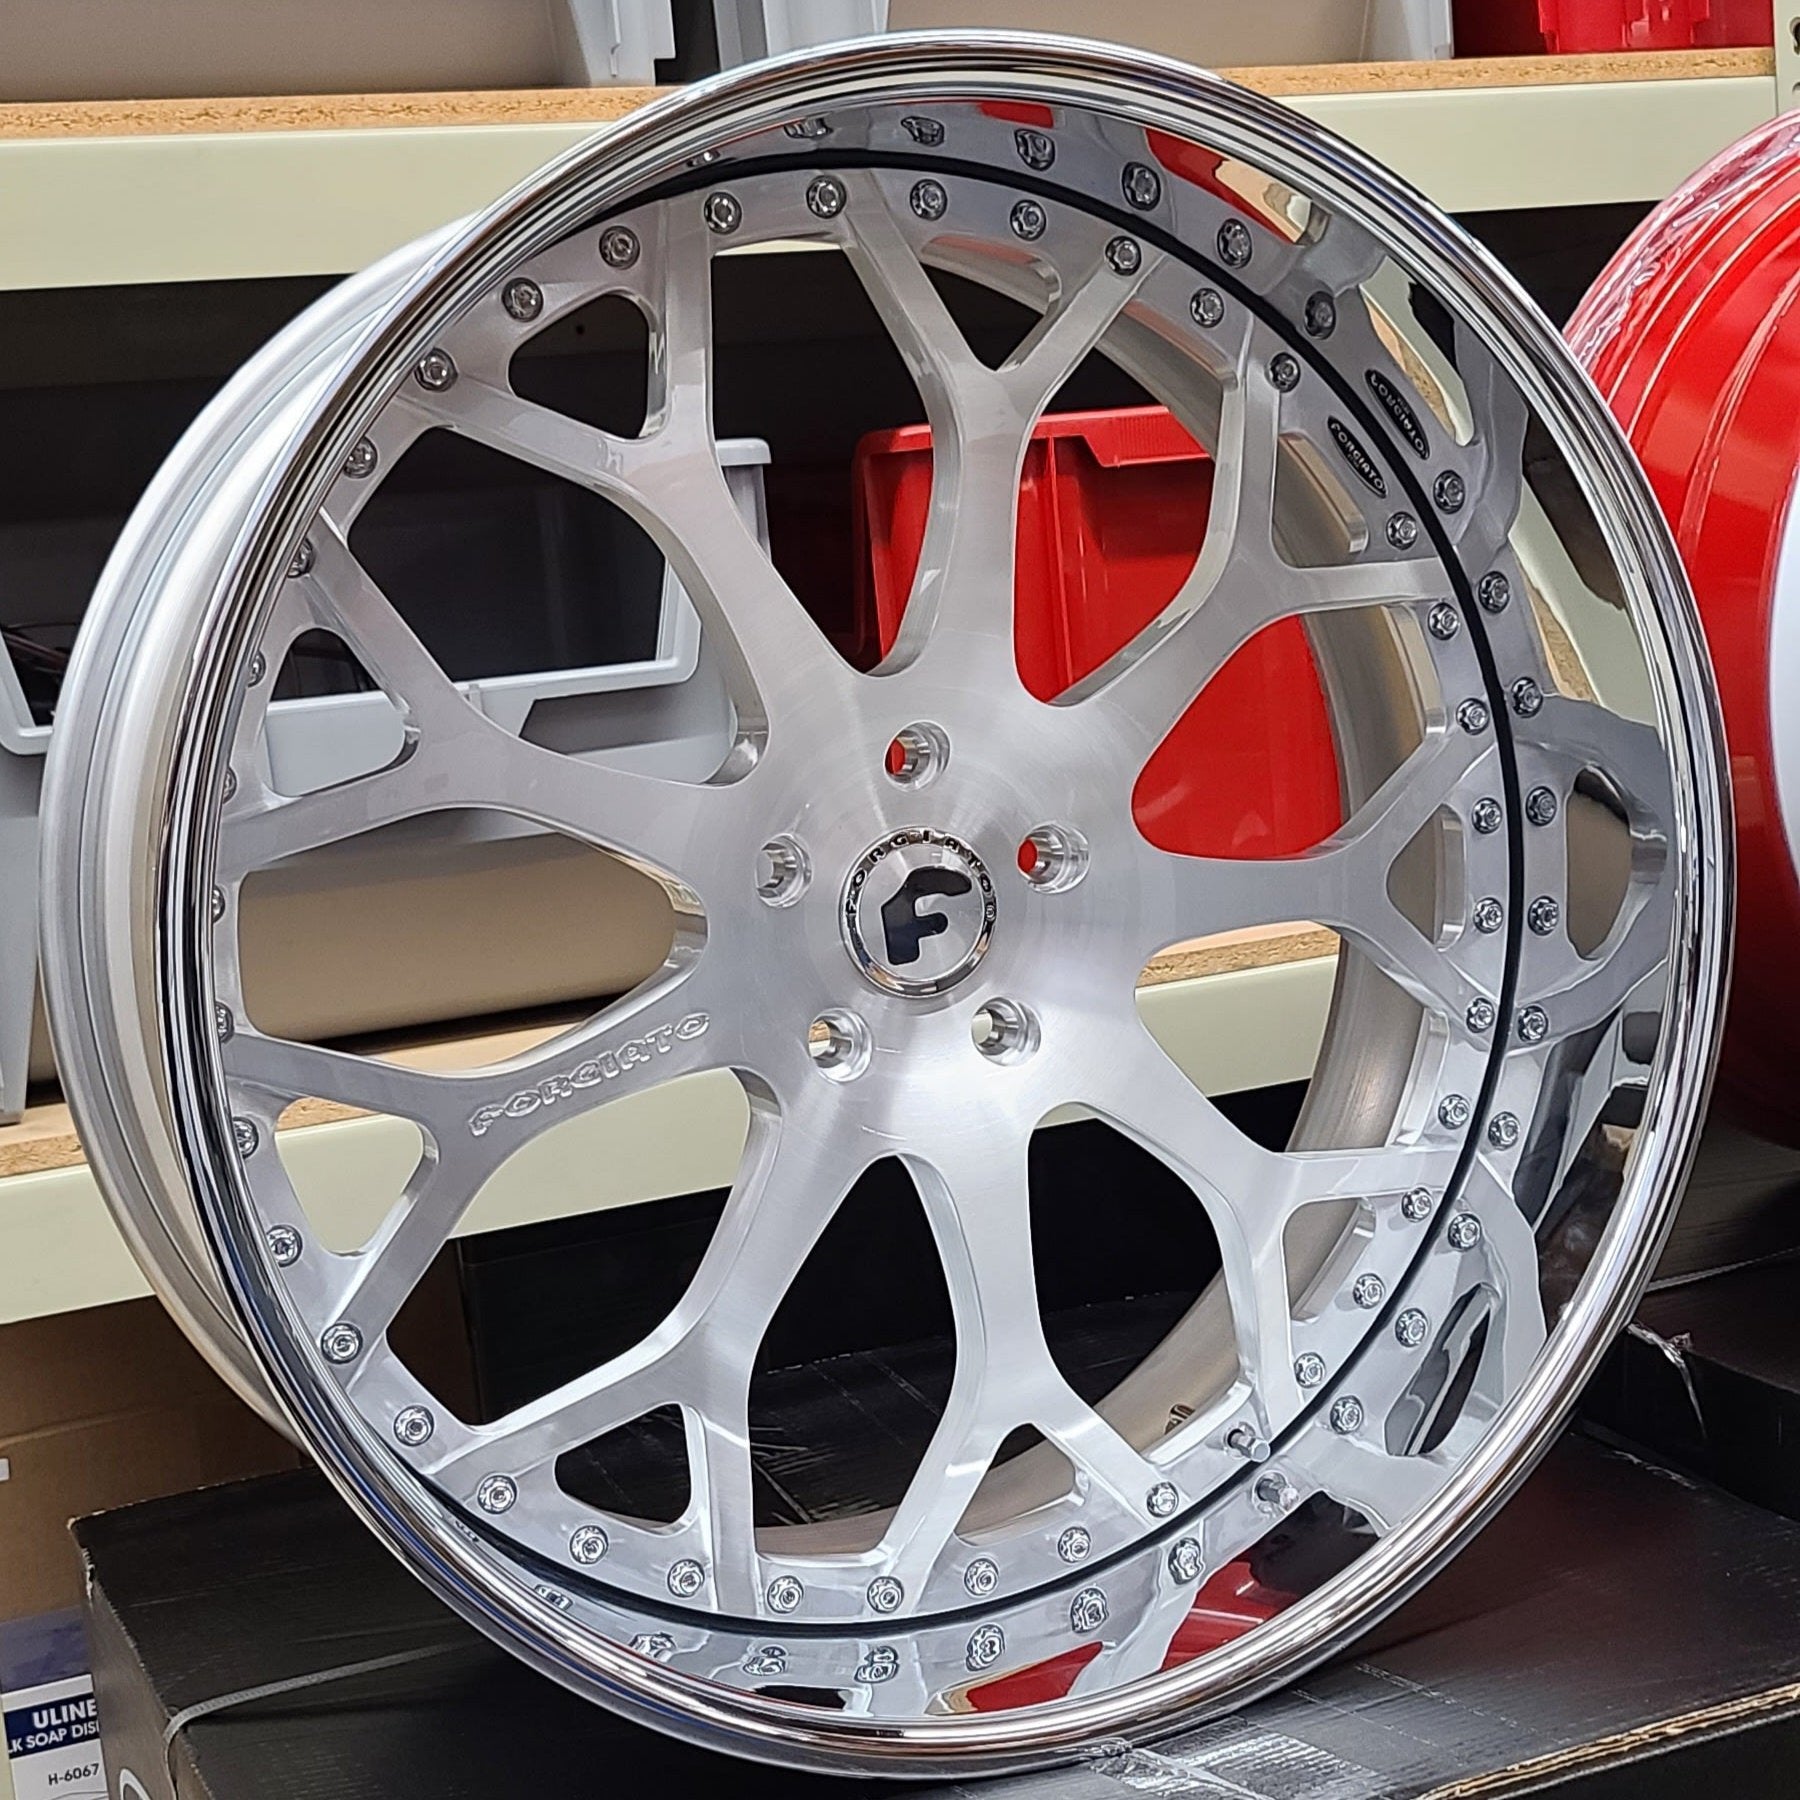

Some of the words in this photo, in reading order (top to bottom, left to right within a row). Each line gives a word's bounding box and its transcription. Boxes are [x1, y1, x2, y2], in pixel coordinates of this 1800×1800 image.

[1330, 422, 1384, 490] FORGIATO
[468, 1012, 709, 1136] FORGIATO
[32, 1698, 98, 1729] ULINE
[26, 1728, 68, 1749] SOAP
[48, 1763, 99, 1785] H-6067
